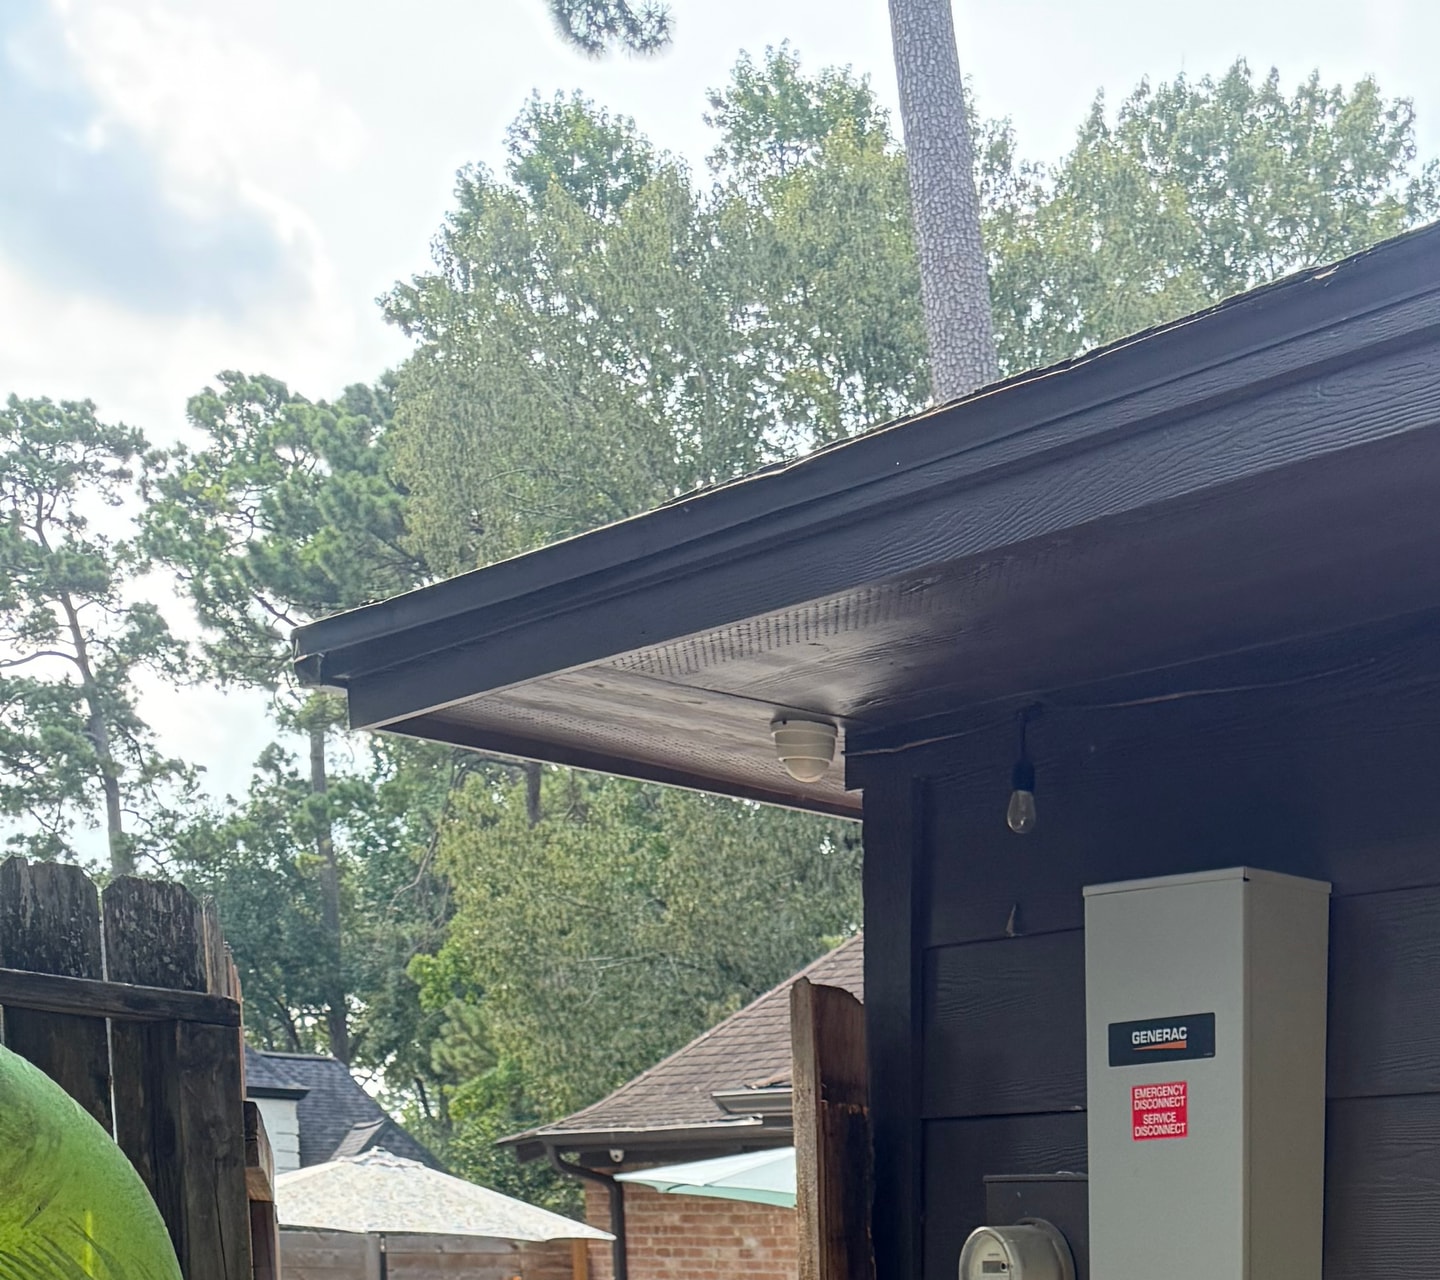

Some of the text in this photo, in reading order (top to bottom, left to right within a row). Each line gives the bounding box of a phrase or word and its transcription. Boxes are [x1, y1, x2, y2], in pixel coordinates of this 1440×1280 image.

[1132, 1026, 1187, 1044] GENERAC
[1134, 1085, 1184, 1098] EMERGENCY
[1134, 1096, 1185, 1110] DISCONNECT
[1143, 1112, 1176, 1124] SERVICE
[1134, 1123, 1186, 1136] DISCONNECT
